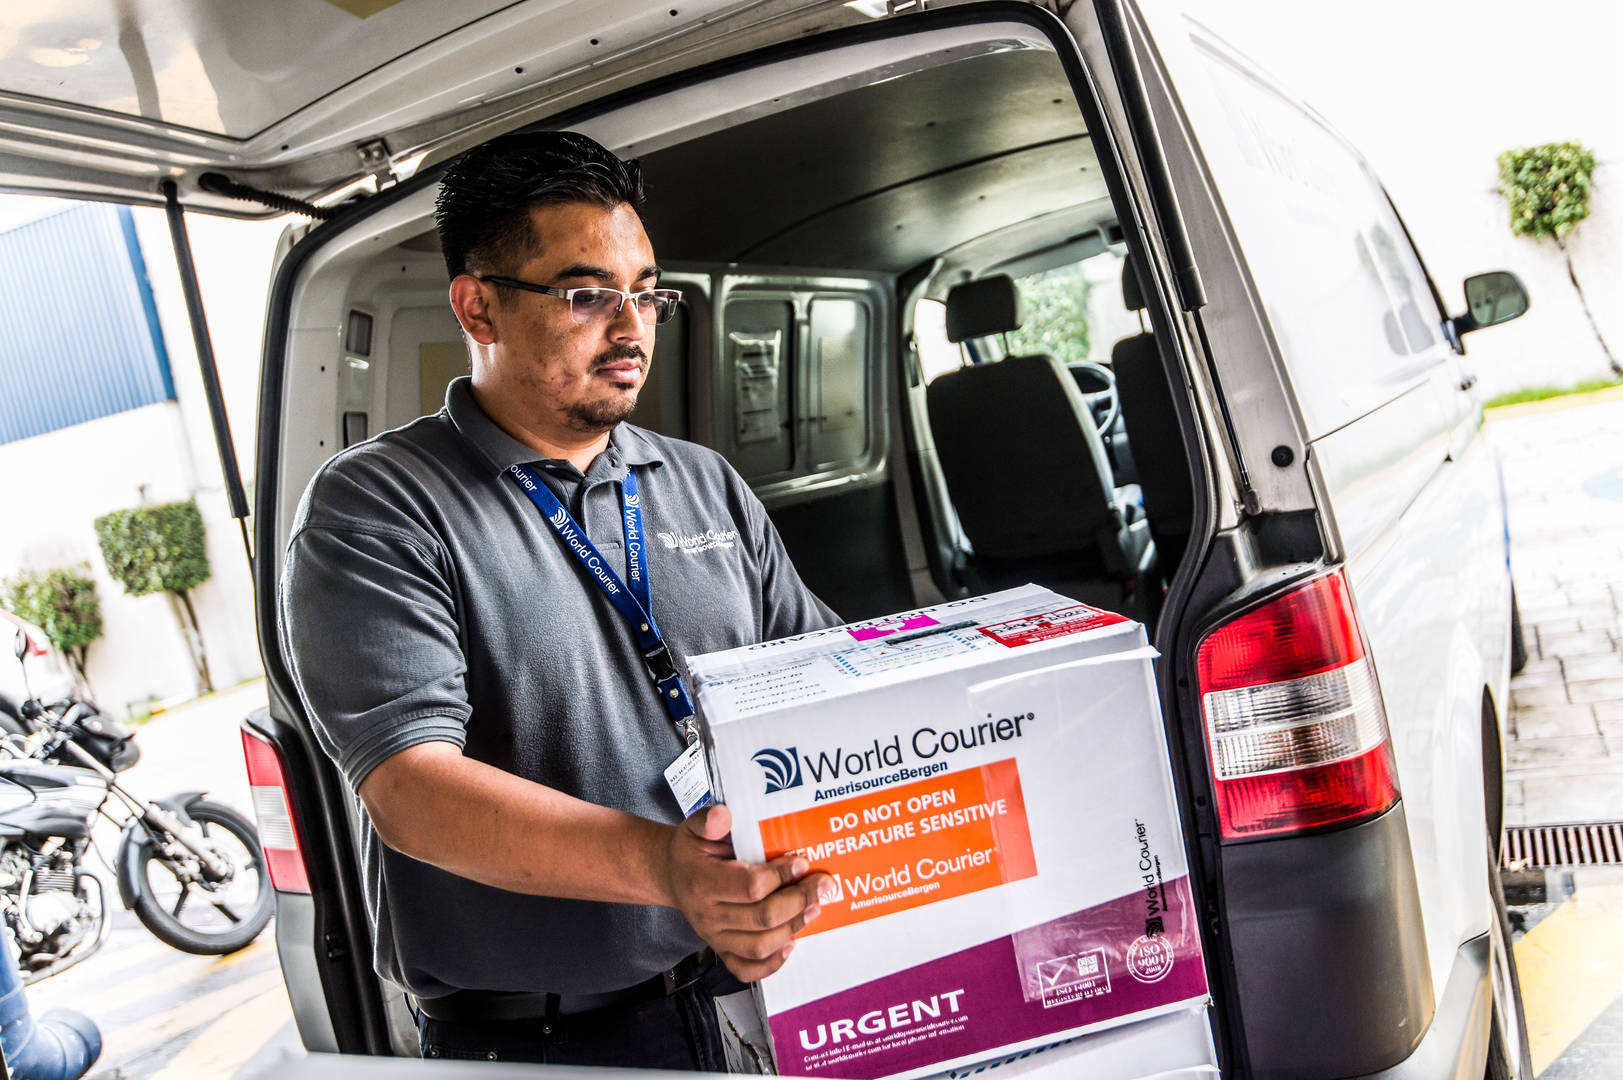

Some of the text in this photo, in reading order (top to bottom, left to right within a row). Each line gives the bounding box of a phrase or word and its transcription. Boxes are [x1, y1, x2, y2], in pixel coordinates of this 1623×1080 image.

[510, 464, 537, 492] ourier
[625, 508, 641, 582] World Courier
[678, 532, 706, 547] World
[562, 523, 621, 595] World Courier
[803, 735, 902, 783] World
[814, 760, 949, 802] AmerisourceBergen
[829, 788, 956, 833] DO NOT OPEN
[921, 798, 1008, 834] SENSITIVE
[844, 863, 912, 898] World
[850, 880, 940, 912] AmerisourceBergen
[1142, 873, 1159, 916] World
[1137, 953, 1165, 968] 9001
[1138, 943, 1161, 958] ISO
[1055, 983, 1072, 996] ISO
[799, 989, 965, 1051] URGENT
